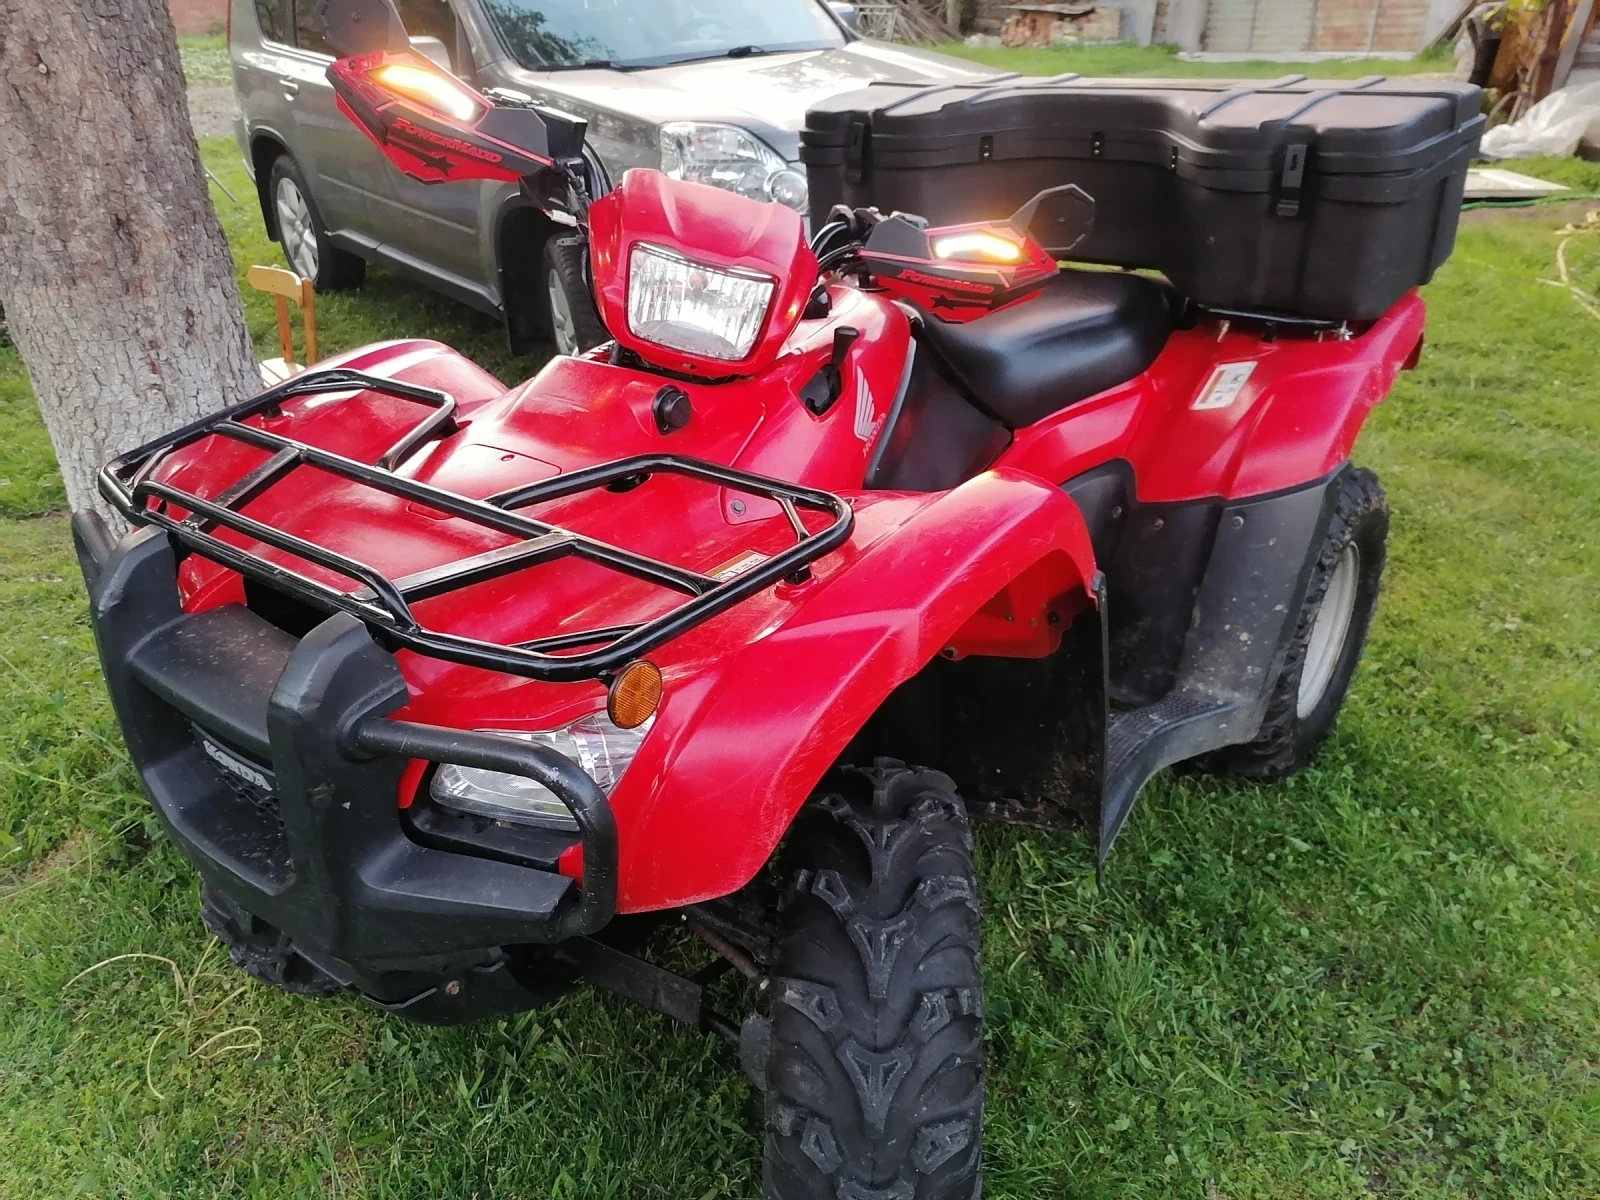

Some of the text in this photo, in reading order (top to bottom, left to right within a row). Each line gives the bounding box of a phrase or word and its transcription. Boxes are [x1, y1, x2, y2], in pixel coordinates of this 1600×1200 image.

[393, 117, 503, 164] POWERMADD
[862, 412, 887, 458] HONDA
[202, 740, 273, 792] HONDA
